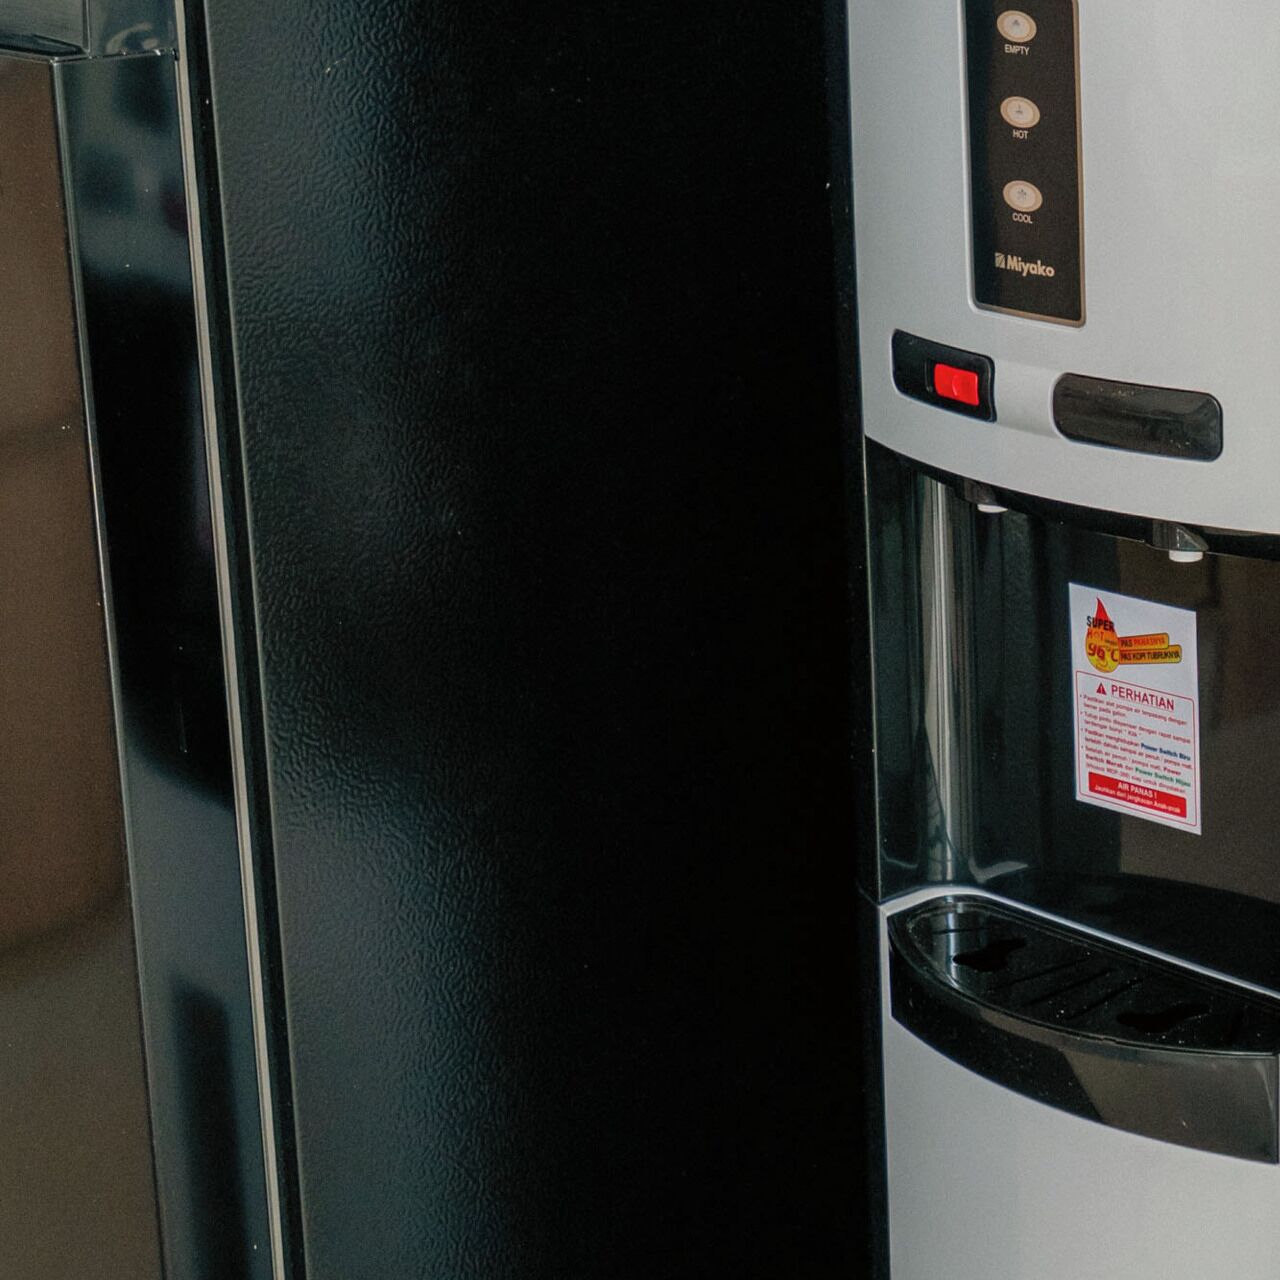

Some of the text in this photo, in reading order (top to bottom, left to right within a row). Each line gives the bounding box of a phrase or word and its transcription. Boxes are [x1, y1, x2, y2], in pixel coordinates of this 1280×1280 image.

[1004, 43, 1030, 56] EMPTY
[1012, 128, 1029, 140] HOT
[1012, 212, 1033, 225] COOL
[1006, 254, 1055, 278] Miyako
[1086, 615, 1115, 633] SUPER
[1087, 629, 1105, 641] HOT
[1111, 684, 1175, 711] PERHATIAN
[1117, 781, 1130, 792] AIR
[1130, 784, 1153, 798] PANAS
